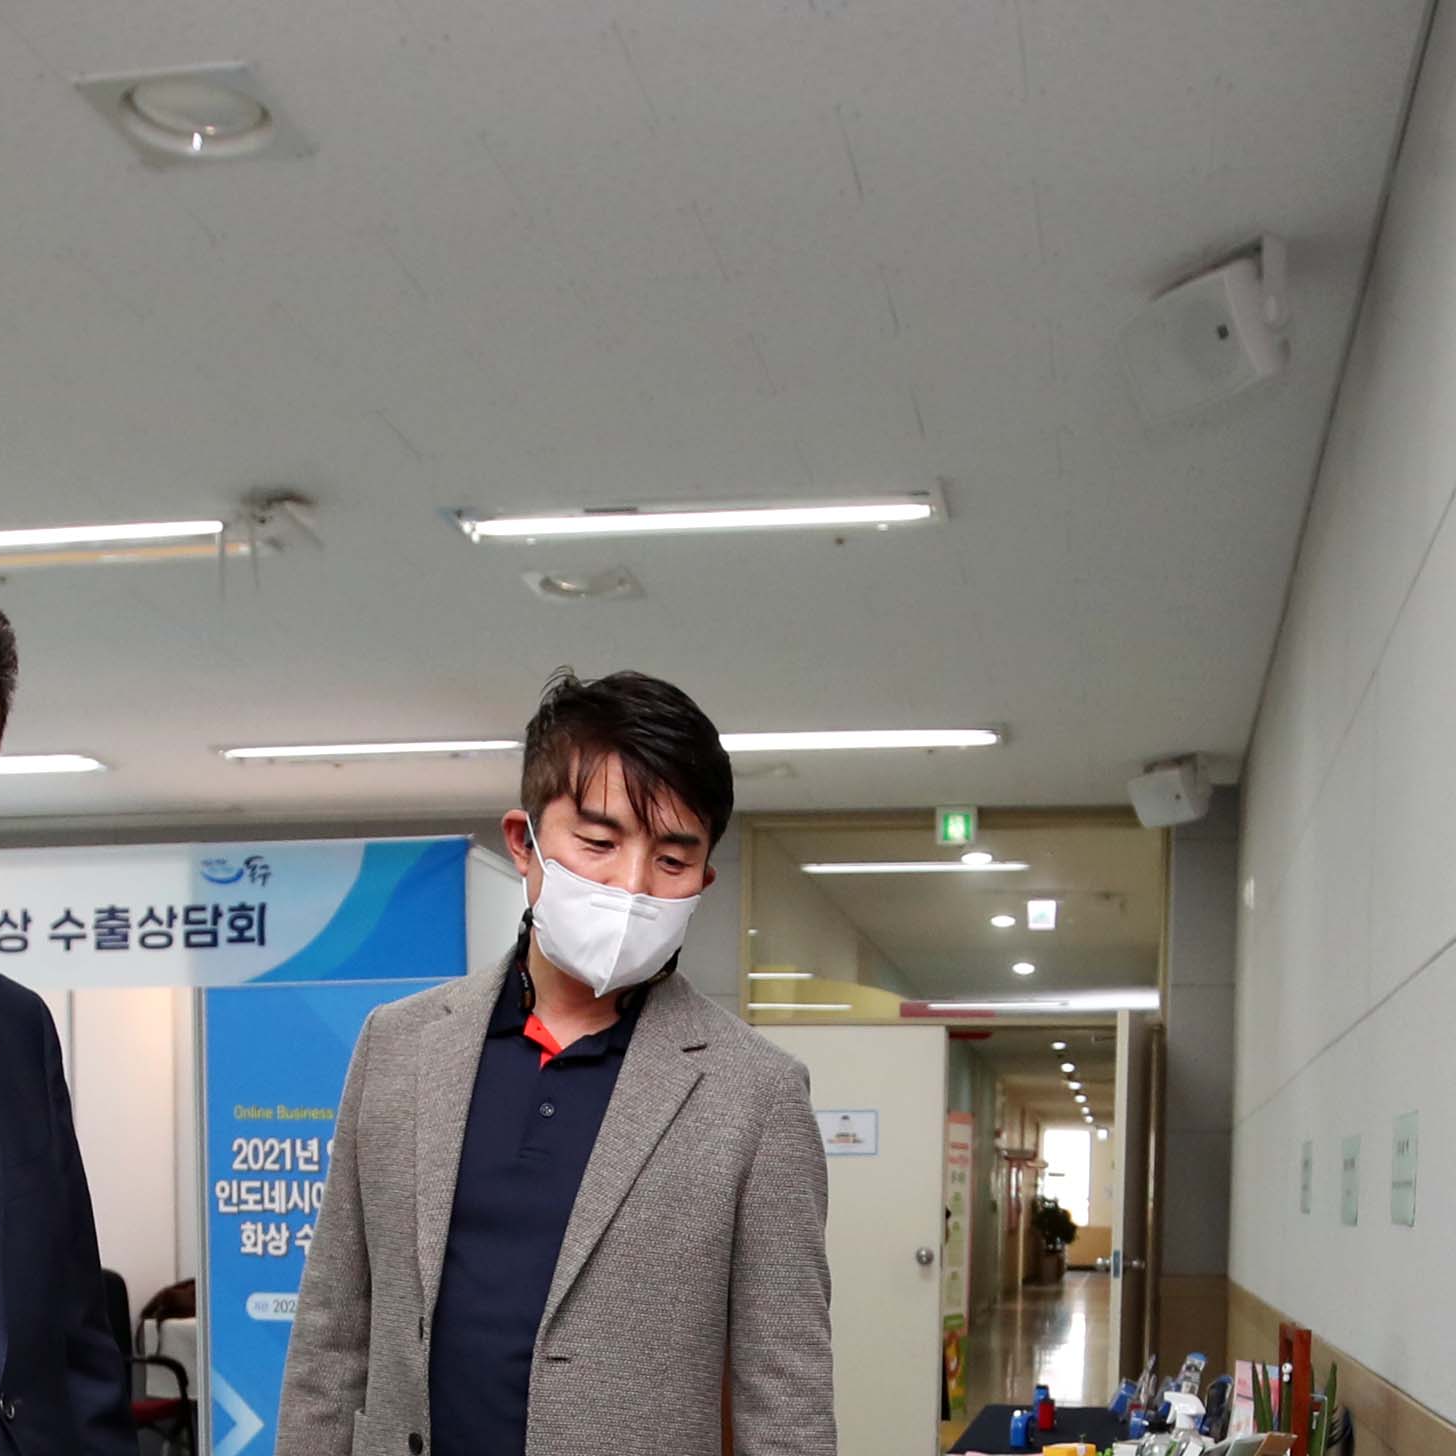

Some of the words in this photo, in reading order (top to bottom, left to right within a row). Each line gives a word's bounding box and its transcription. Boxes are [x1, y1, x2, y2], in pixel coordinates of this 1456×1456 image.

[48, 902, 266, 951] 수출상담회
[234, 1104, 273, 1120] Online
[277, 1104, 334, 1120] Business
[232, 1137, 320, 1171] 2021년
[240, 1221, 290, 1256] 화상
